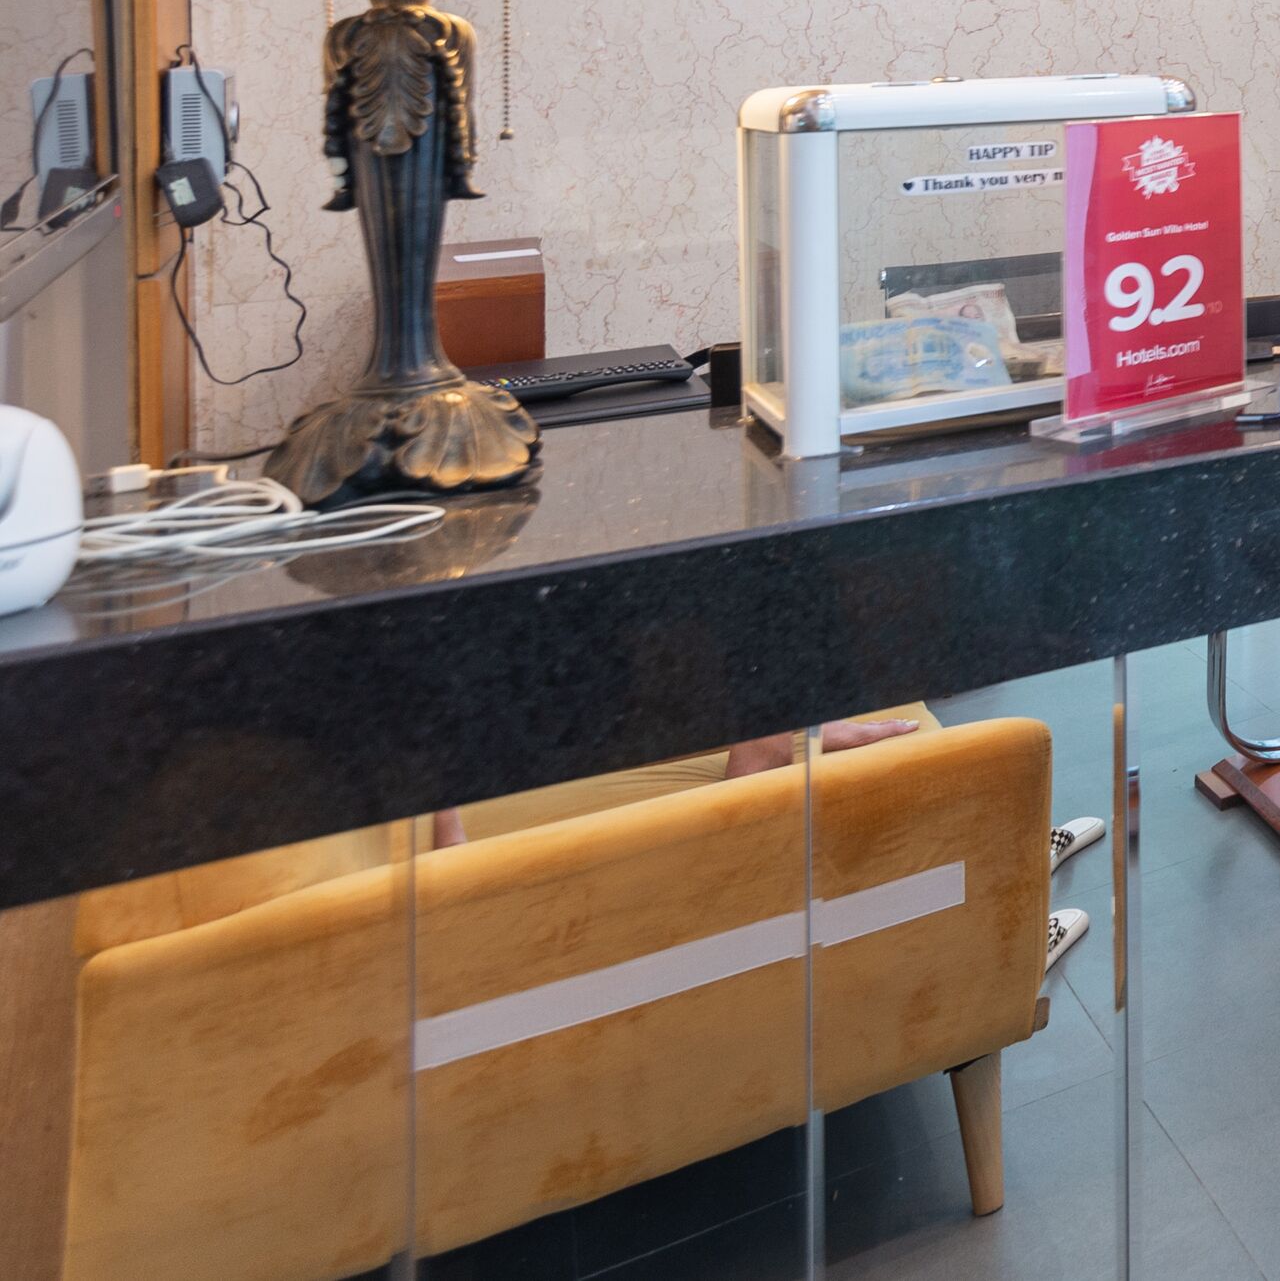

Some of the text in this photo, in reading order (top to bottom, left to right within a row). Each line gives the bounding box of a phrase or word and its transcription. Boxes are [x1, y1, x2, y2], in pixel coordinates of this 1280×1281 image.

[968, 143, 1054, 161] HAPPY TIP
[922, 176, 974, 192] Thank
[979, 175, 1009, 189] you
[1014, 172, 1047, 185] very
[1105, 220, 1209, 243] Golden Sun Villa Hotel
[1104, 254, 1206, 332] 9.2
[1115, 339, 1201, 369] Hotels.com
